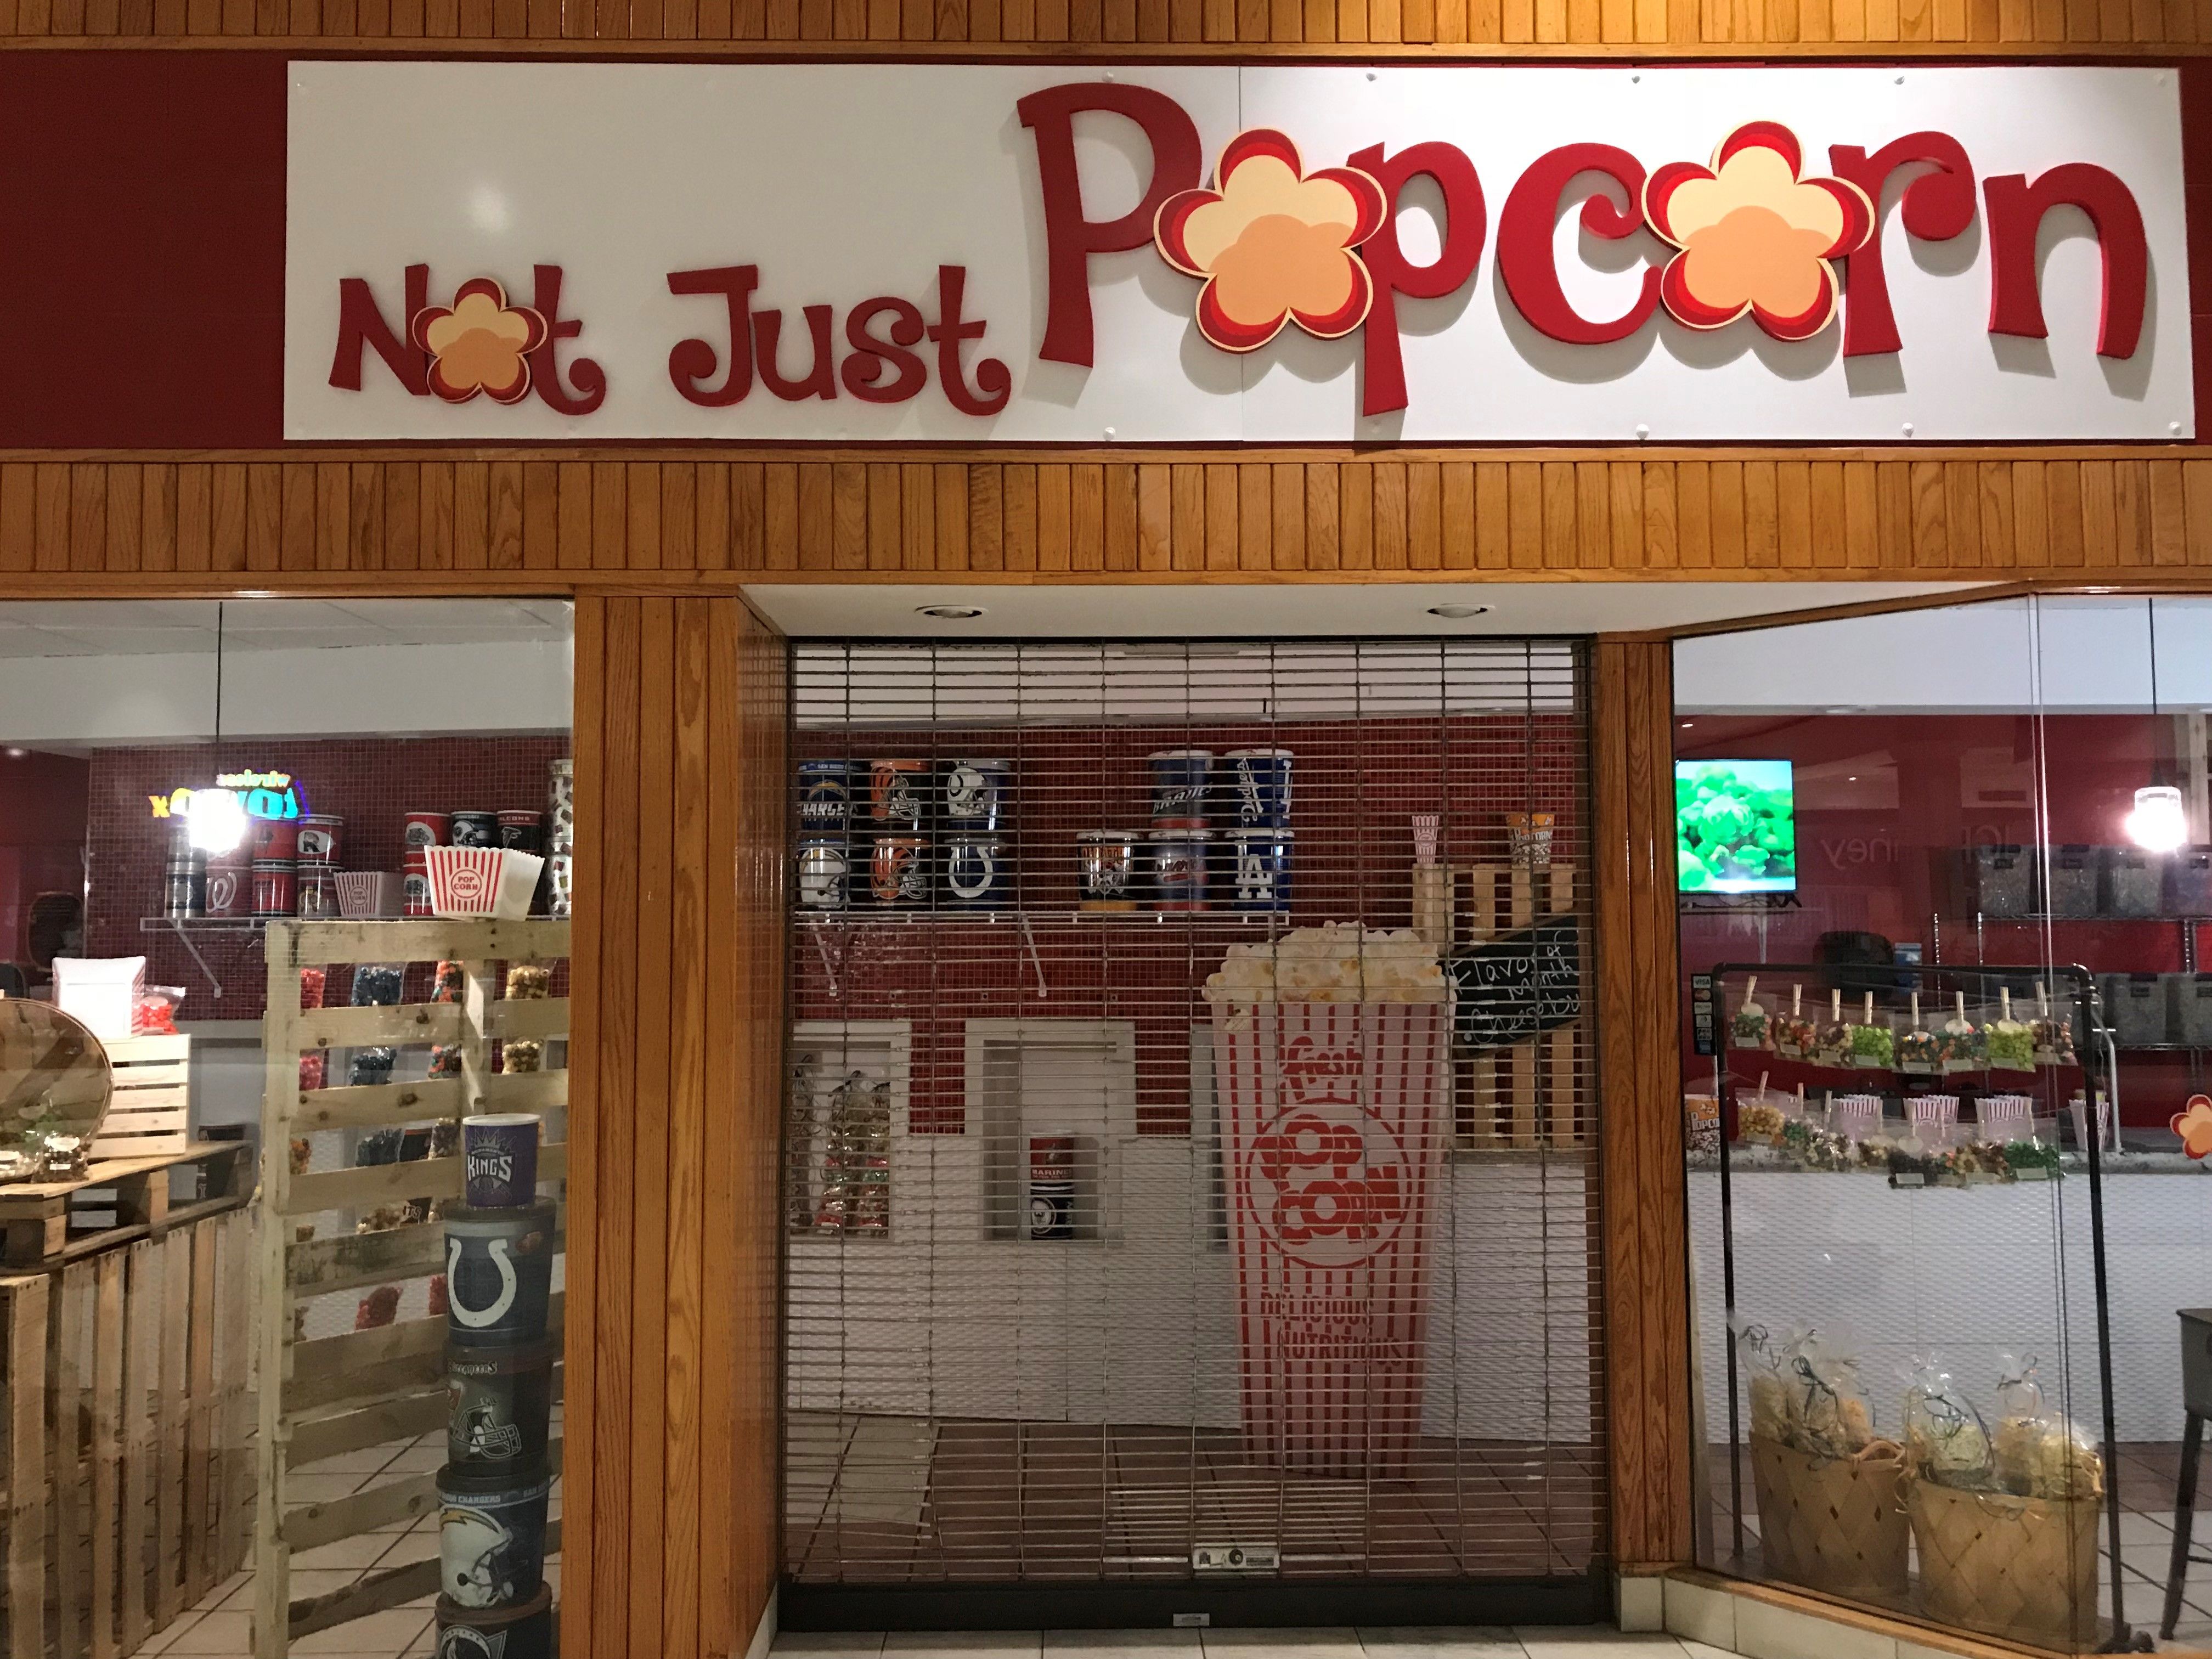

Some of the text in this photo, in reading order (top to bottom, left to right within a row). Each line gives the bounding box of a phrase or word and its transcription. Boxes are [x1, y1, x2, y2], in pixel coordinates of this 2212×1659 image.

[667, 263, 1011, 416] Just
[454, 882, 478, 890] CORN
[467, 1155, 513, 1182] KINGS
[1260, 1114, 1363, 1190] POP
[1272, 1161, 1401, 1245] CORN
